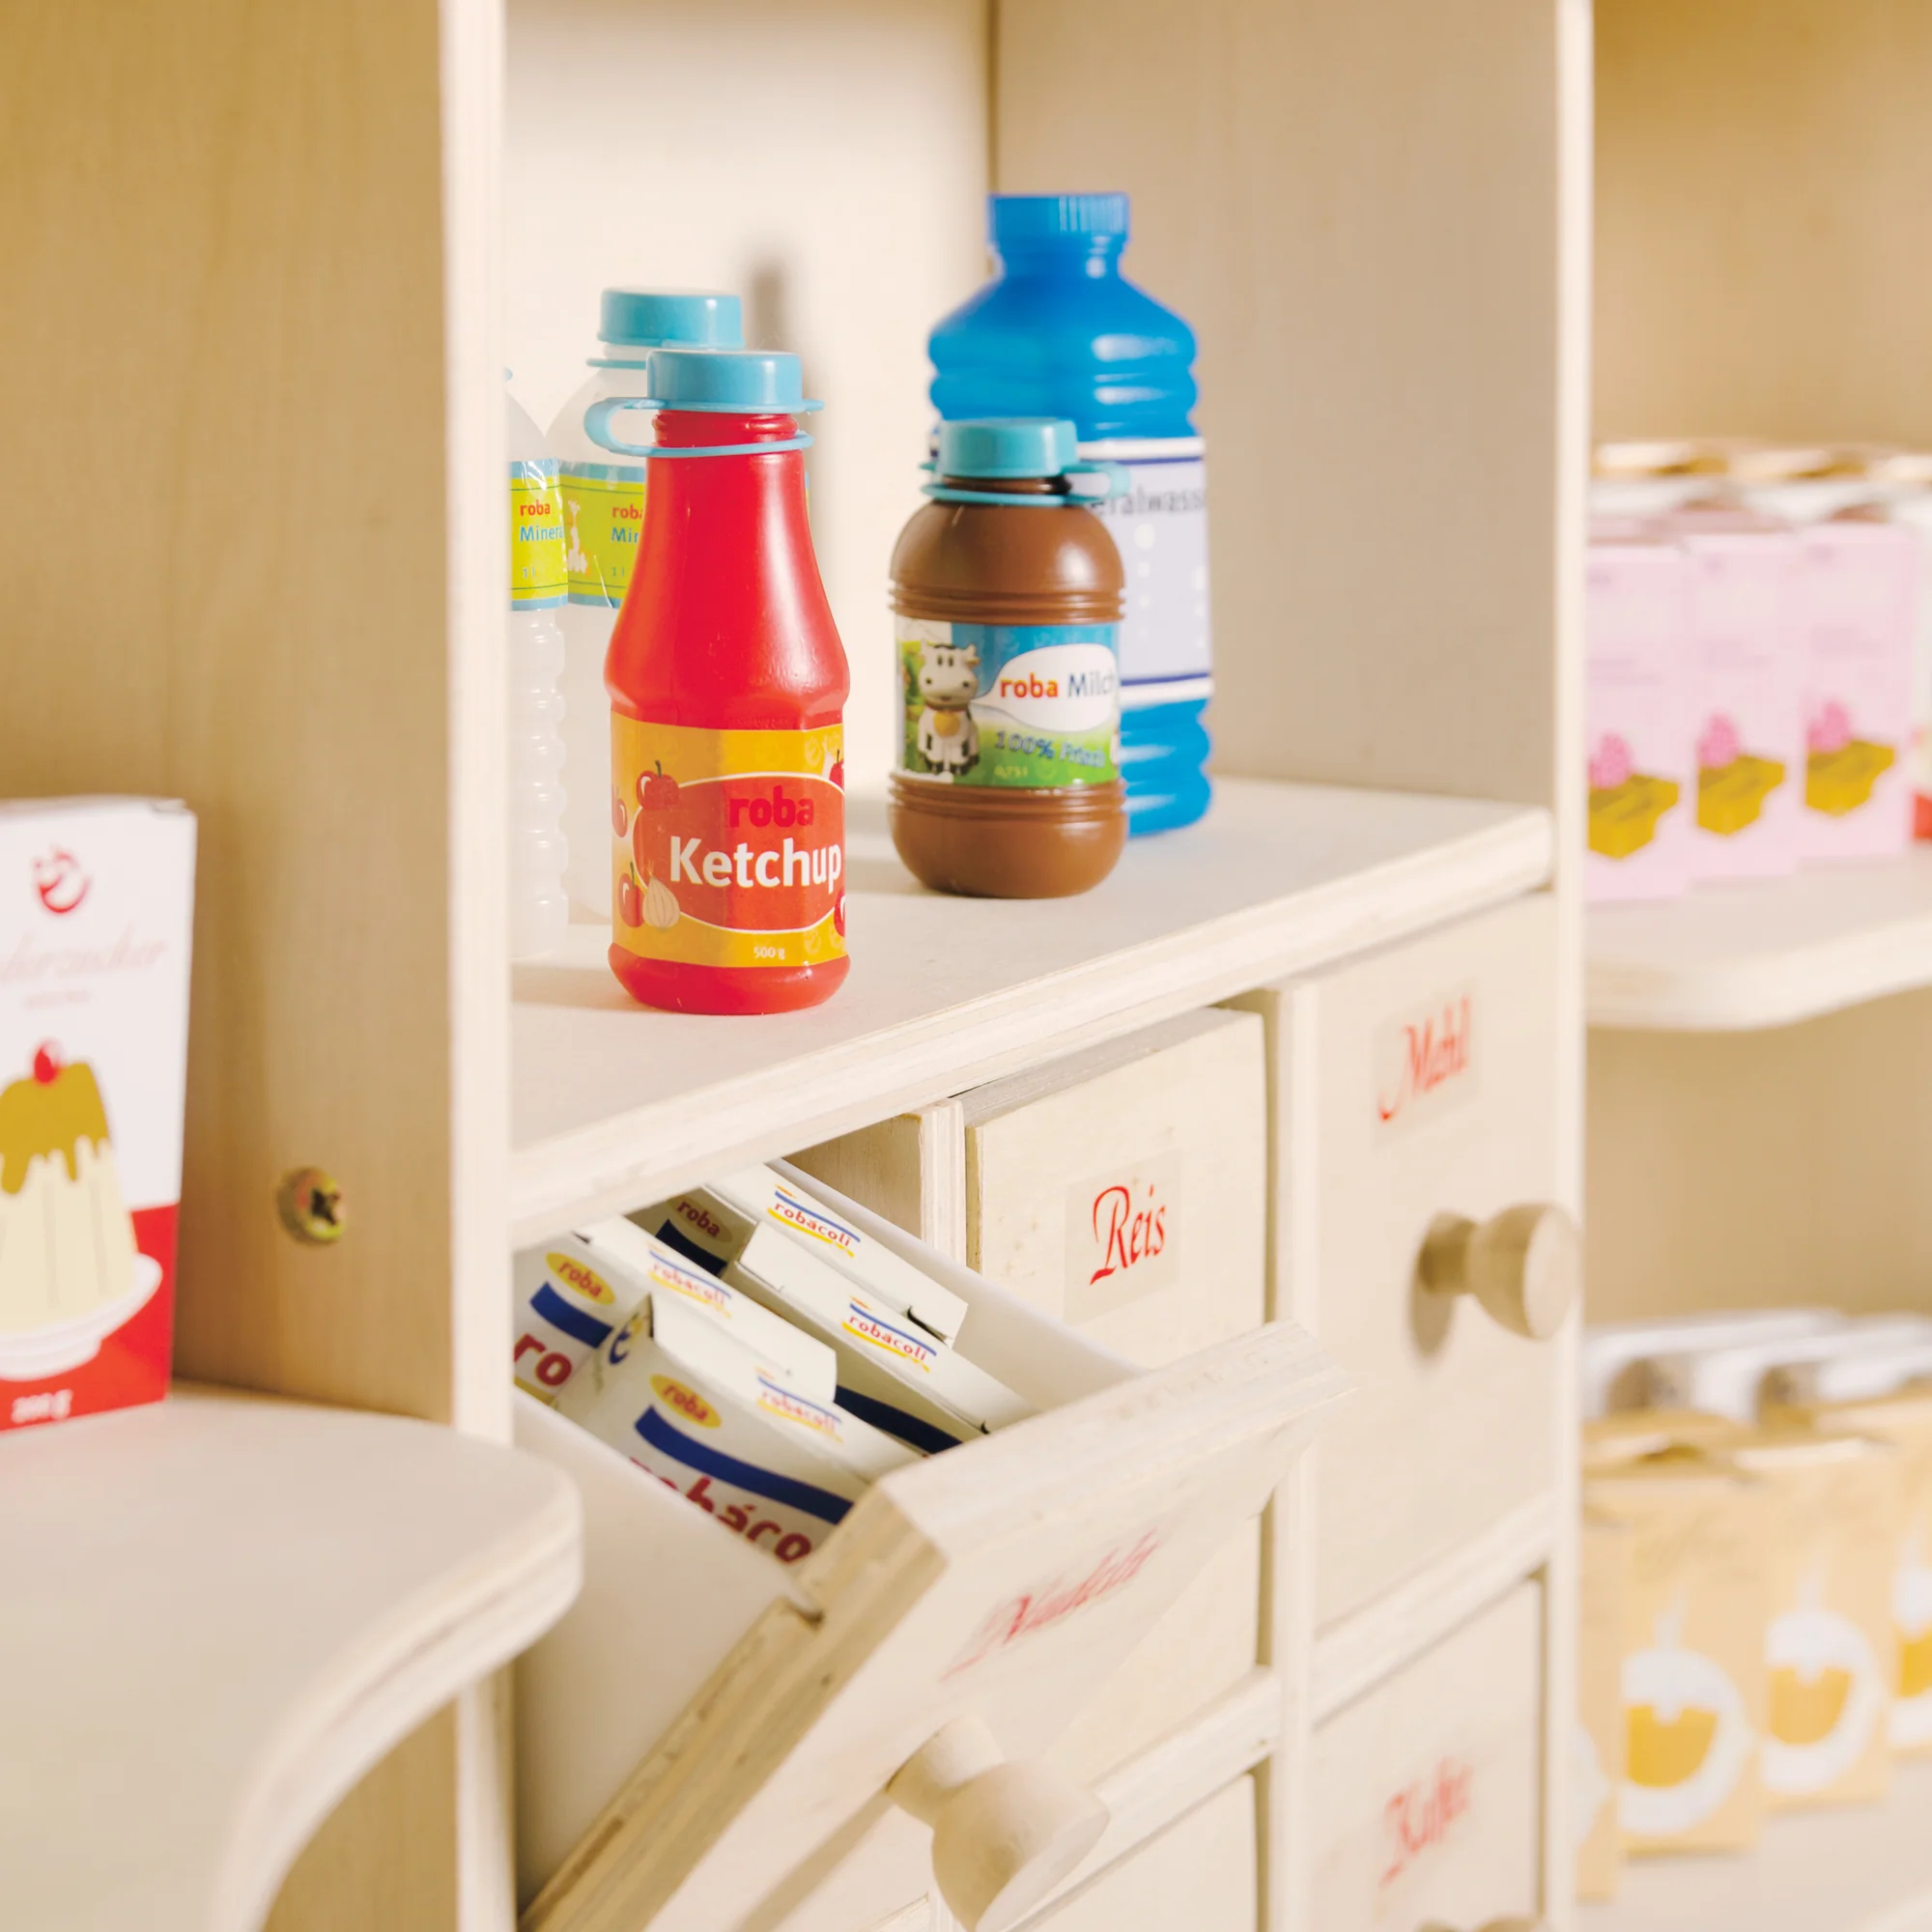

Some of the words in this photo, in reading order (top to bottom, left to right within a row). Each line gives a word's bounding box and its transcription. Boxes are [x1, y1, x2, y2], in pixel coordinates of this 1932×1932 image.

[520, 499, 551, 516] roba
[1000, 672, 1059, 698] roba
[995, 730, 1055, 760] 100%
[729, 785, 814, 828] roba
[670, 836, 841, 895] Ketchup
[753, 947, 776, 959] 500
[778, 948, 785, 960] g
[675, 1200, 722, 1238] roba
[1090, 1183, 1166, 1286] Reis
[557, 1261, 604, 1298] roba
[662, 1384, 709, 1422] roba
